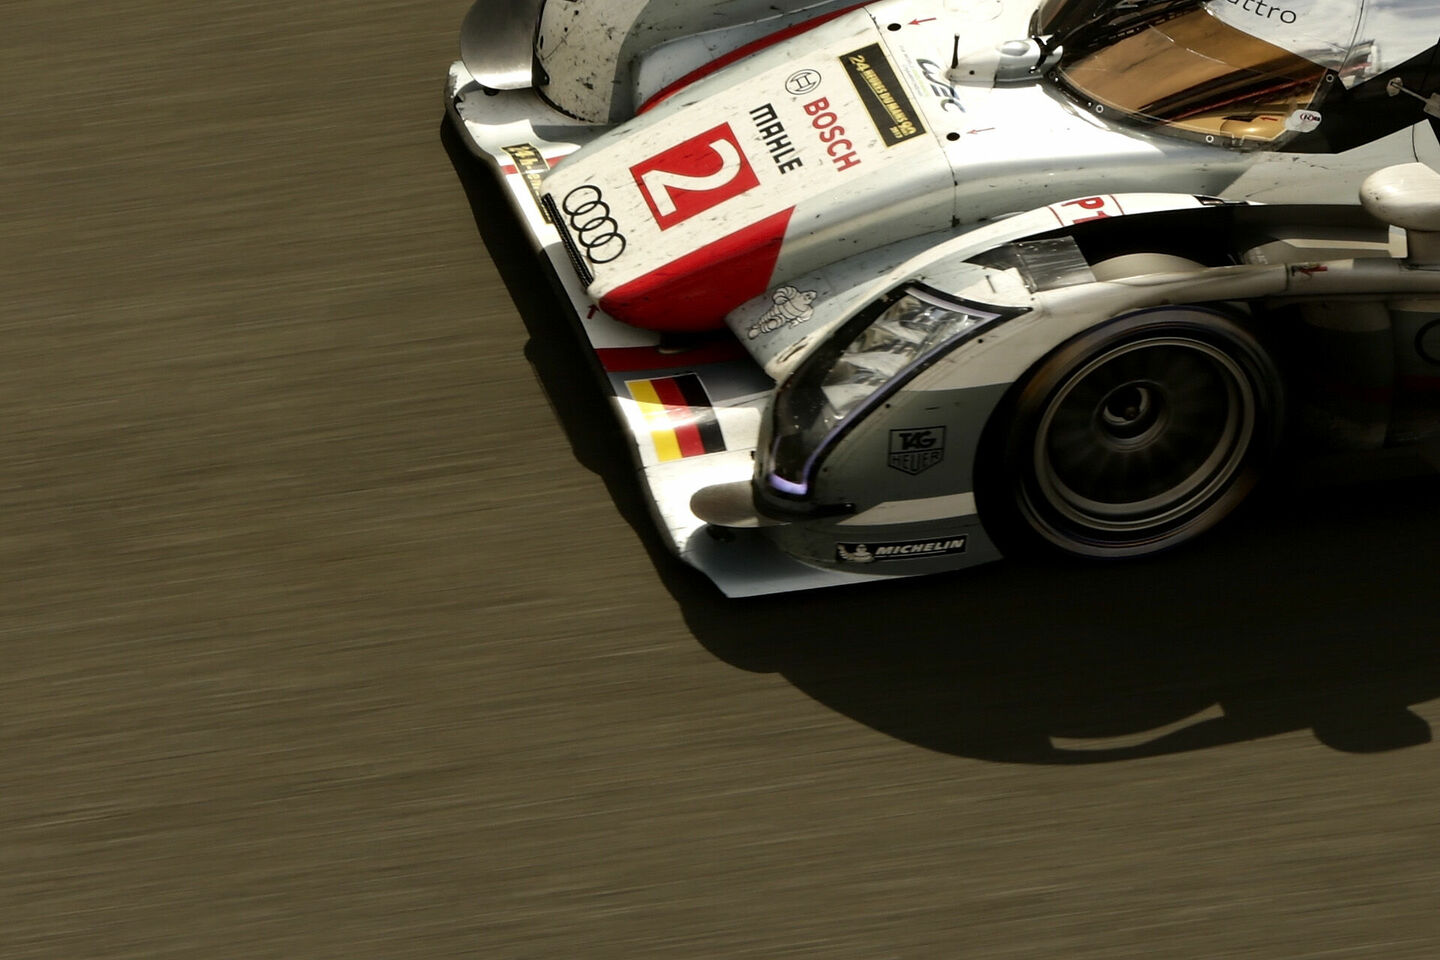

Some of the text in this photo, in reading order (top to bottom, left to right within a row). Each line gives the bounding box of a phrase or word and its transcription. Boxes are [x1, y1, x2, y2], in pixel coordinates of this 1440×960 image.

[848, 54, 871, 72] 24
[862, 69, 888, 95] HEURES
[879, 92, 895, 104] DU
[886, 102, 909, 123] MANS
[749, 103, 803, 174] MAHLE
[803, 96, 862, 172] BOSCH
[640, 138, 742, 217] 2
[1060, 197, 1112, 224] P1
[898, 430, 937, 451] TAG
[892, 451, 941, 472] HEUER
[875, 539, 965, 556] MICHELIN
